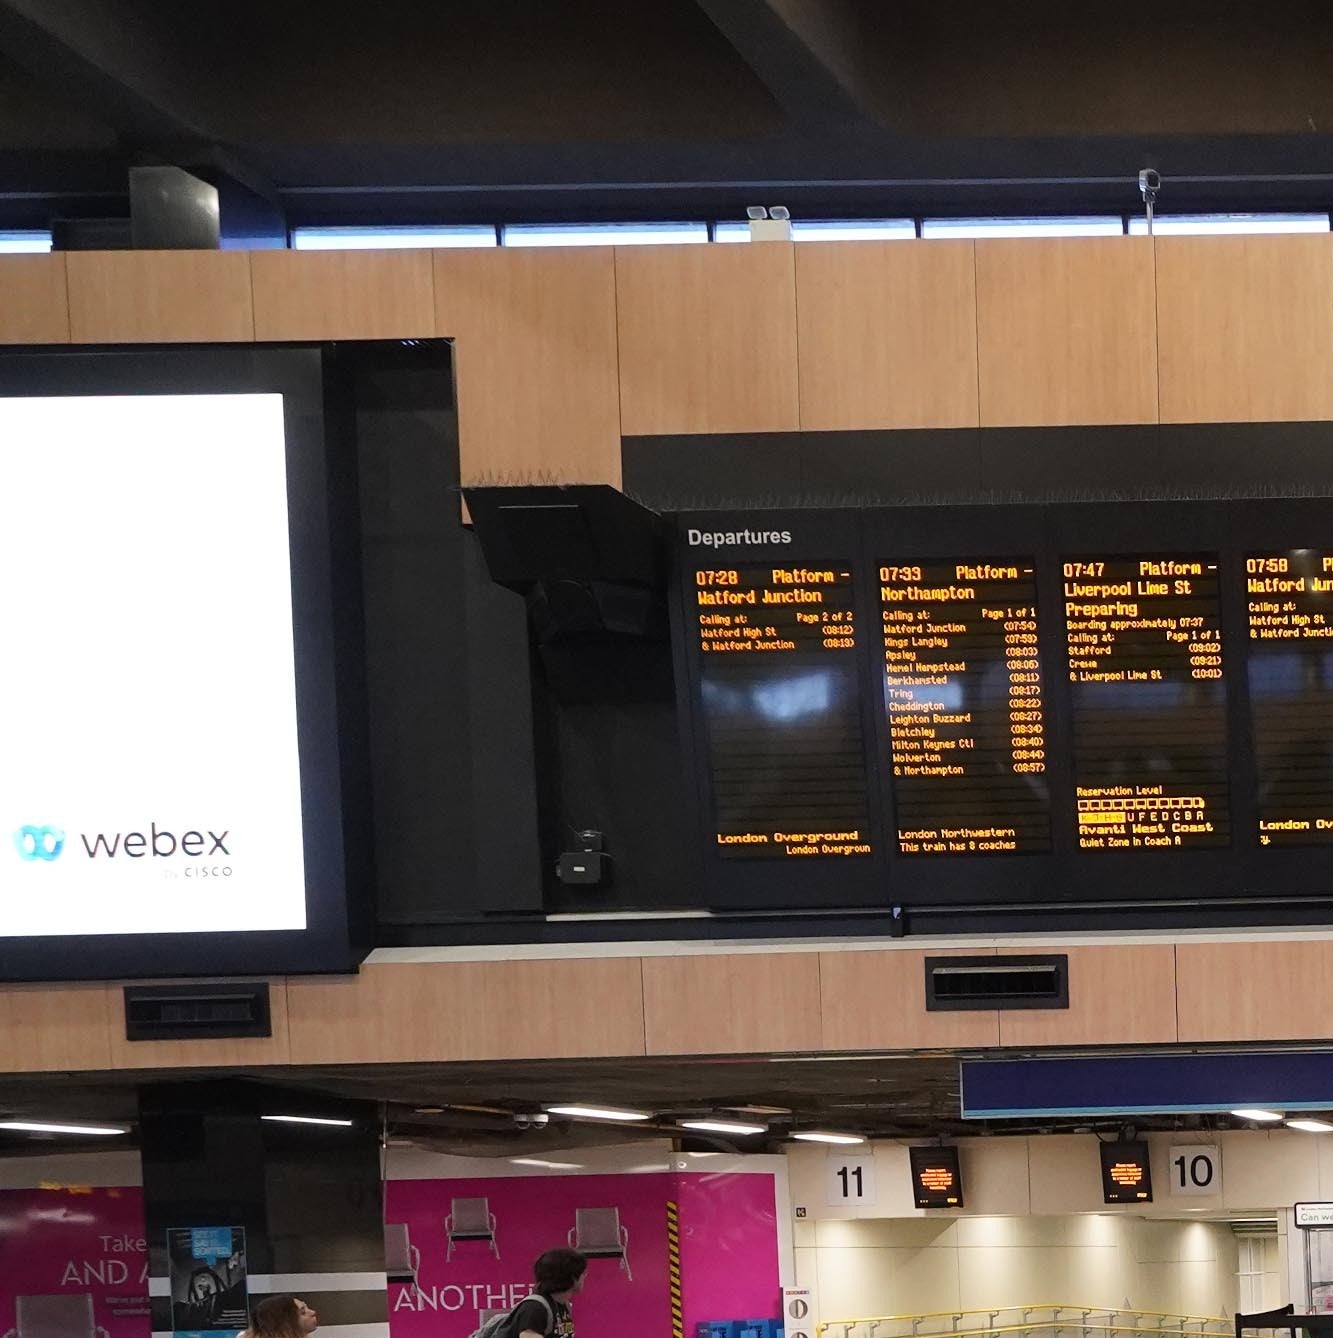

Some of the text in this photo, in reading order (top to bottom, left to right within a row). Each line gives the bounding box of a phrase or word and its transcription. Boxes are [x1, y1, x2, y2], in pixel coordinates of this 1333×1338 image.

[688, 528, 791, 548] Departures
[880, 565, 1017, 581] 07:33 Platform
[1064, 561, 1201, 577] 07:47 Platform
[1247, 559, 1288, 573] 07:58
[696, 569, 834, 585] 07:28 Platform
[1248, 578, 1305, 592] Watford
[698, 589, 822, 604] Watford Junction
[881, 586, 974, 601] Northampton
[1065, 580, 1191, 598] Liverpool Lime St
[1066, 601, 1138, 617] Preparing
[81, 822, 230, 858] webex
[718, 831, 858, 843] London Overground
[184, 866, 232, 878] CISCO
[1174, 1154, 1214, 1188] 10
[836, 1166, 863, 1198] 11
[1301, 1213, 1319, 1221] Can
[100, 1235, 147, 1252] Take
[61, 1260, 128, 1286] AND
[394, 1283, 536, 1311] ANOTHE
